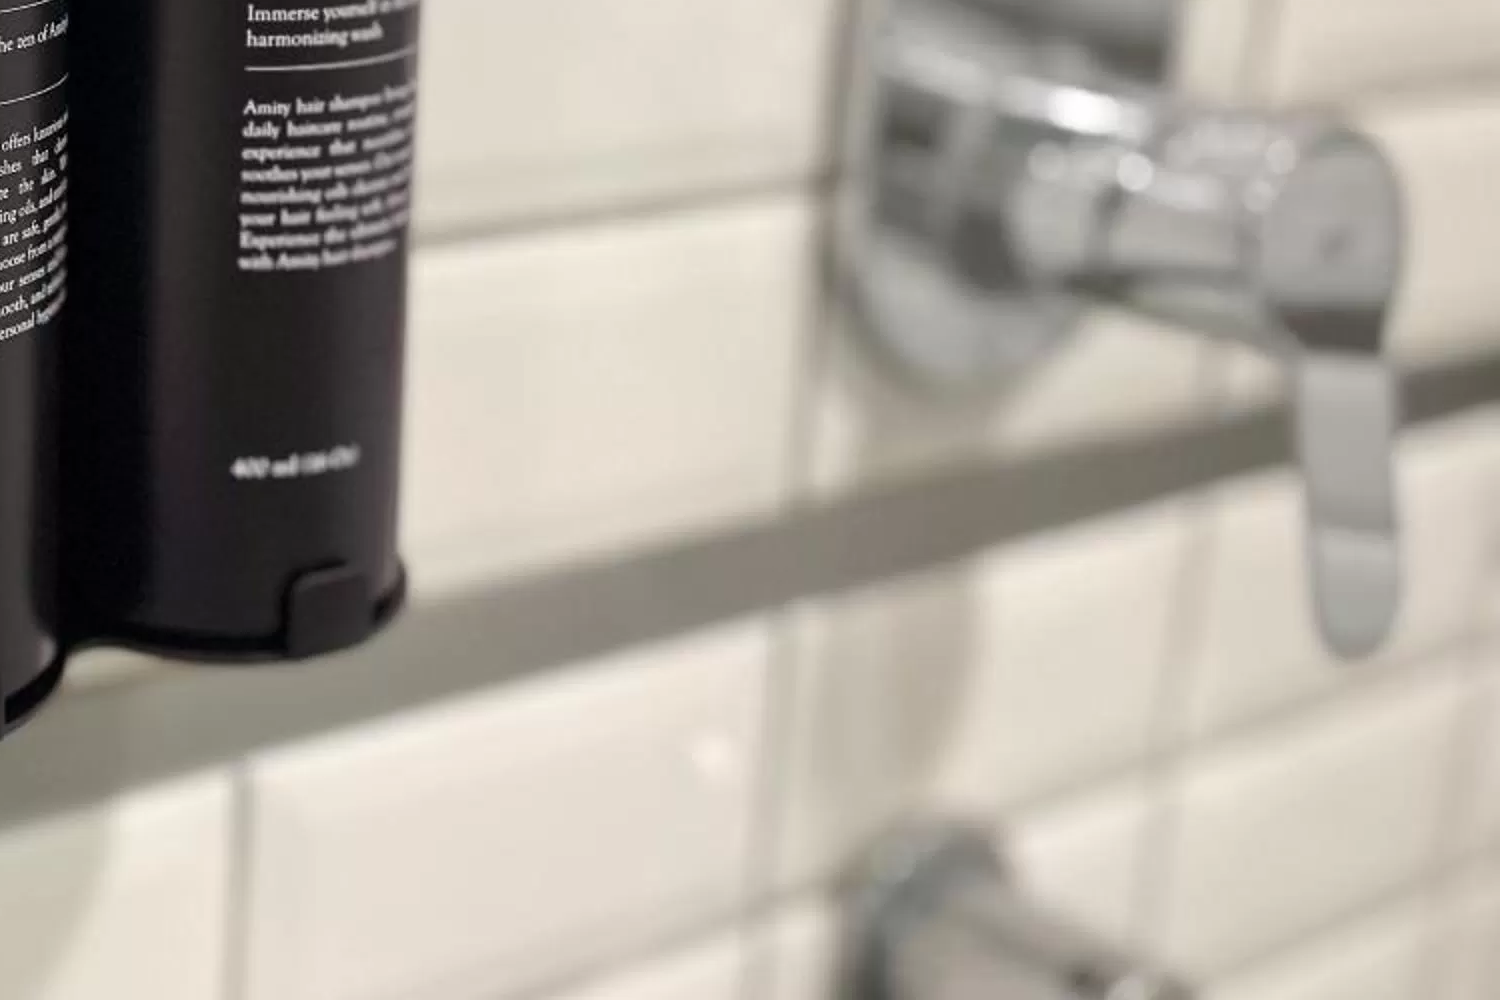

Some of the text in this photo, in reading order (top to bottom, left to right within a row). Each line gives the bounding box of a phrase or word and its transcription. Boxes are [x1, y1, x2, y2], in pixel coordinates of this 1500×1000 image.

[248, 3, 320, 21] Immerse
[18, 34, 35, 48] zen
[38, 24, 48, 42] of
[247, 29, 349, 48] harmonizing
[243, 98, 292, 118] Amity
[242, 121, 281, 140] daily
[1, 131, 31, 152] offers
[3, 233, 19, 246] are
